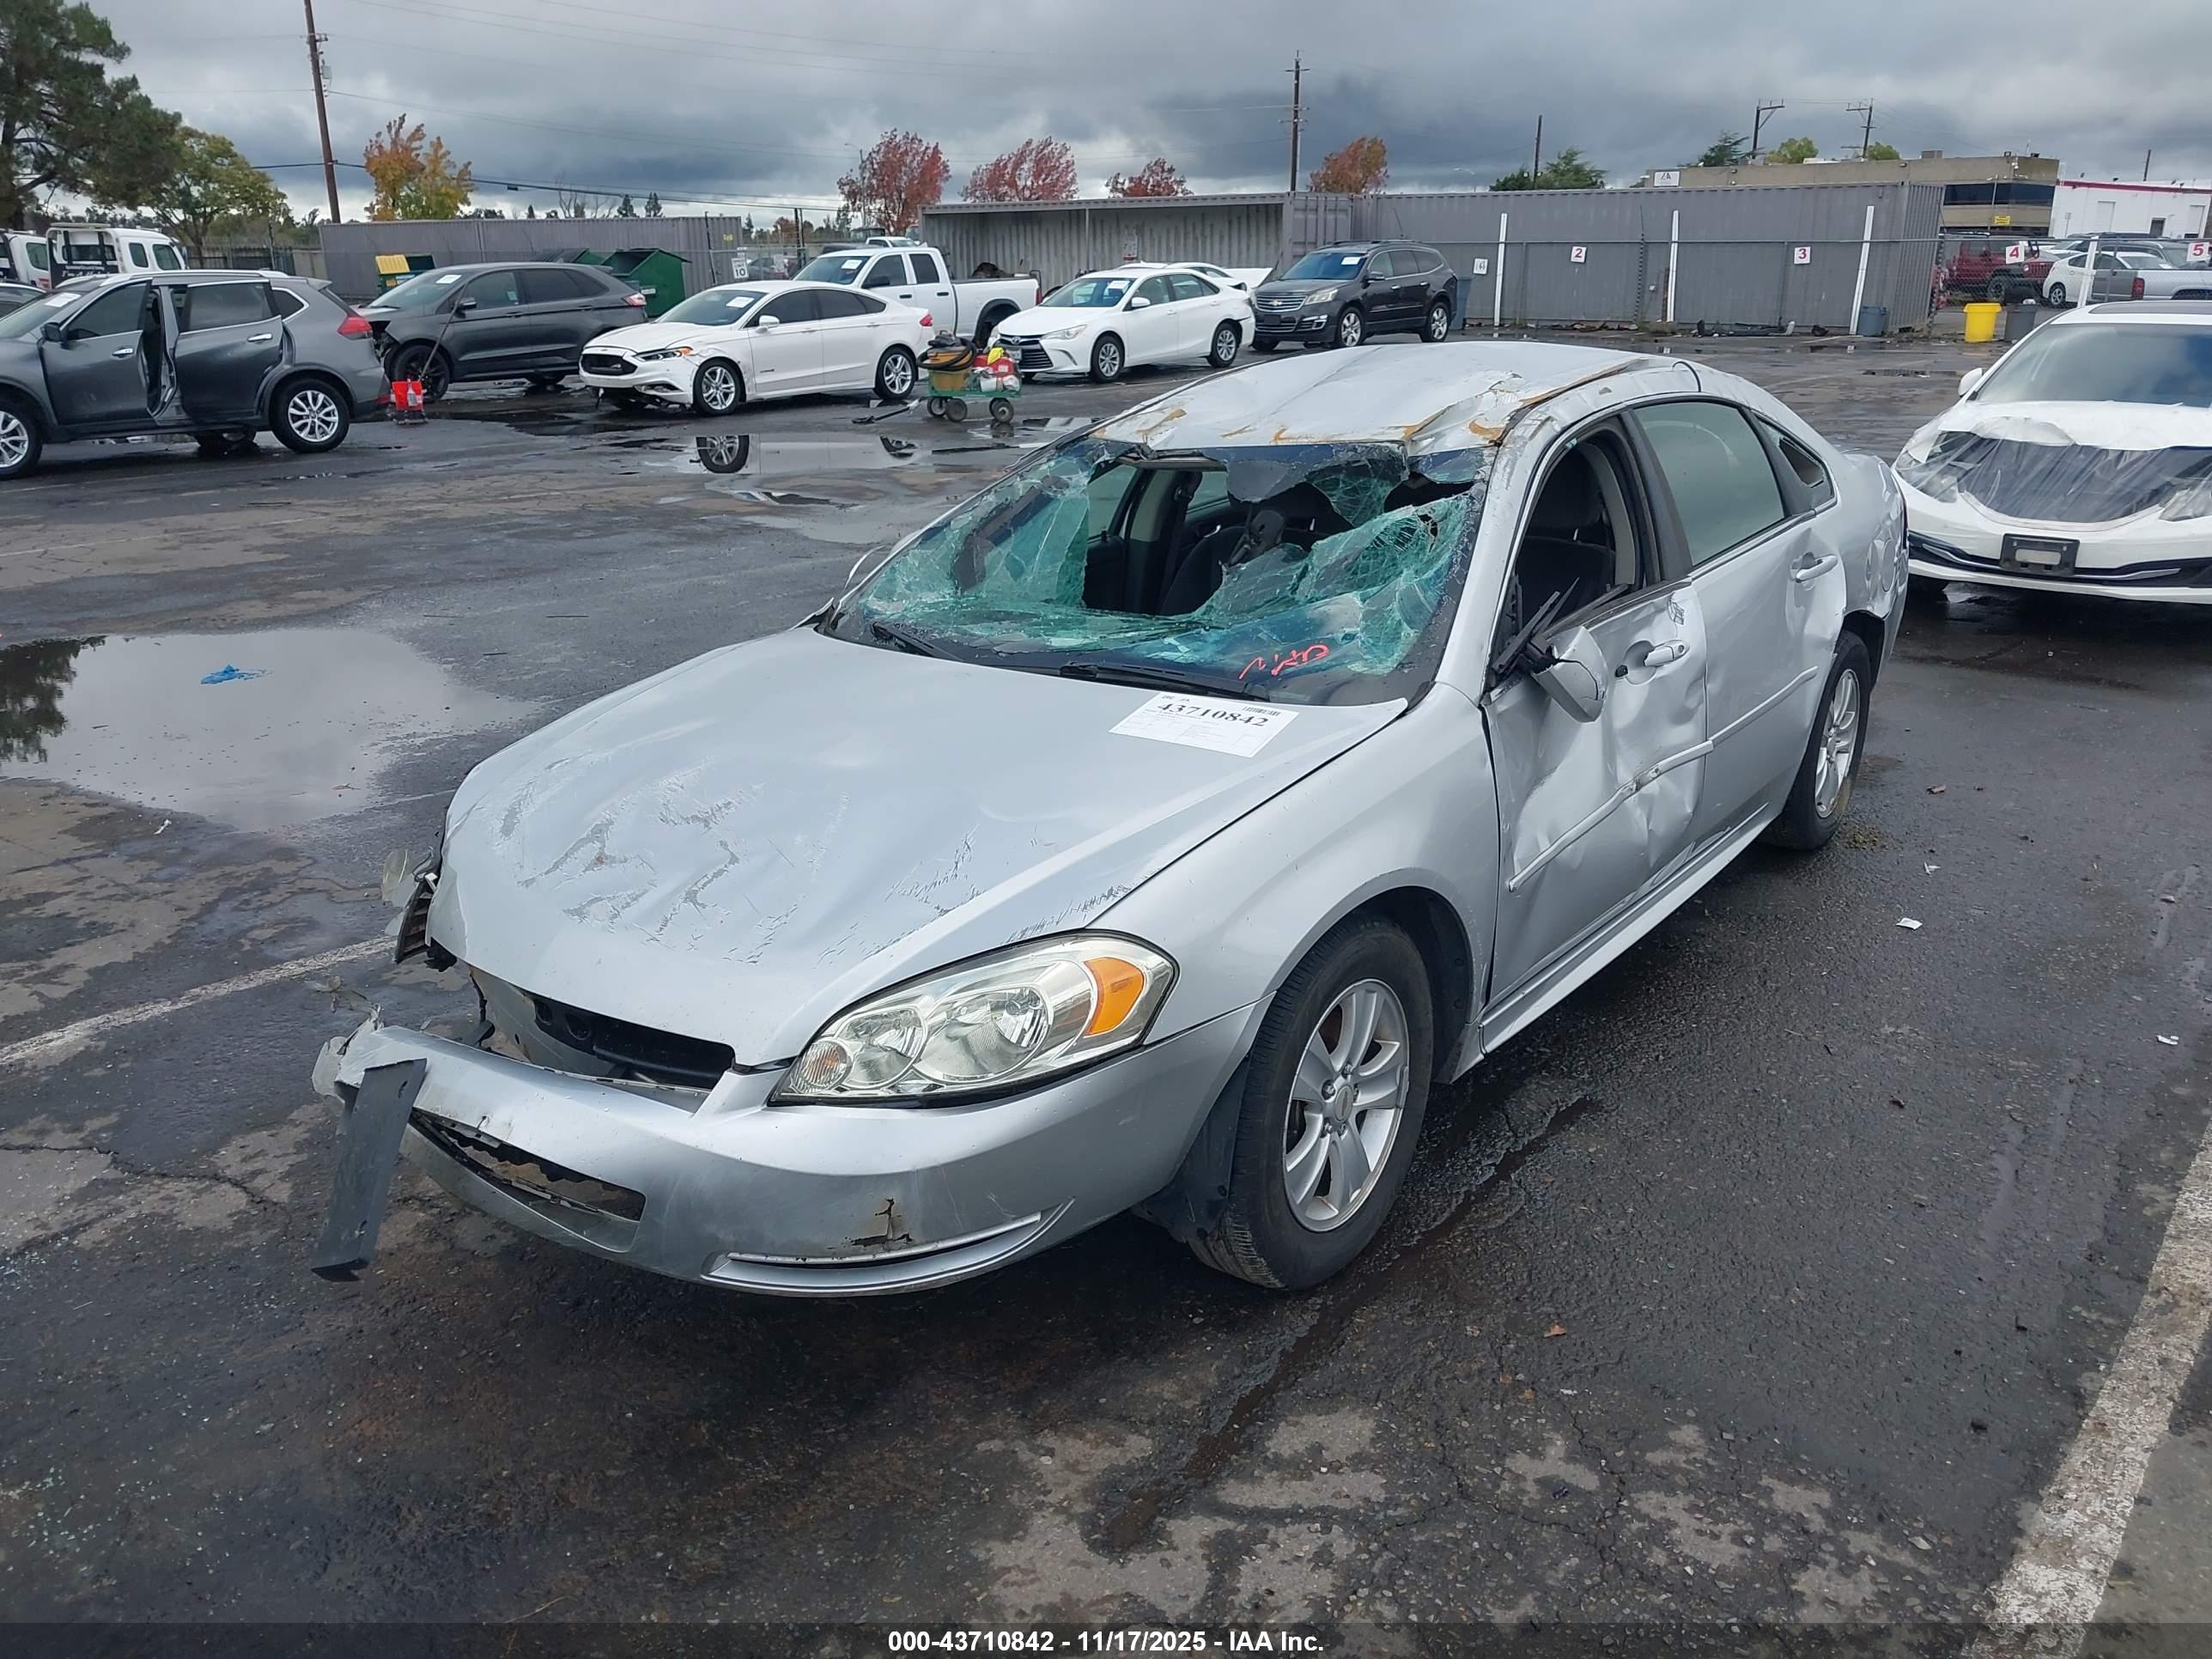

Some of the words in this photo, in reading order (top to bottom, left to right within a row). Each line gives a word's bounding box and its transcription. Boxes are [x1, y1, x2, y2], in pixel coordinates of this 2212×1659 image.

[1574, 248, 1583, 258] 2
[1798, 248, 1807, 259] 3
[2009, 247, 2019, 258] 4
[2192, 244, 2204, 256] 5
[735, 268, 746, 276] 10
[1158, 703, 1269, 726] 43710842
